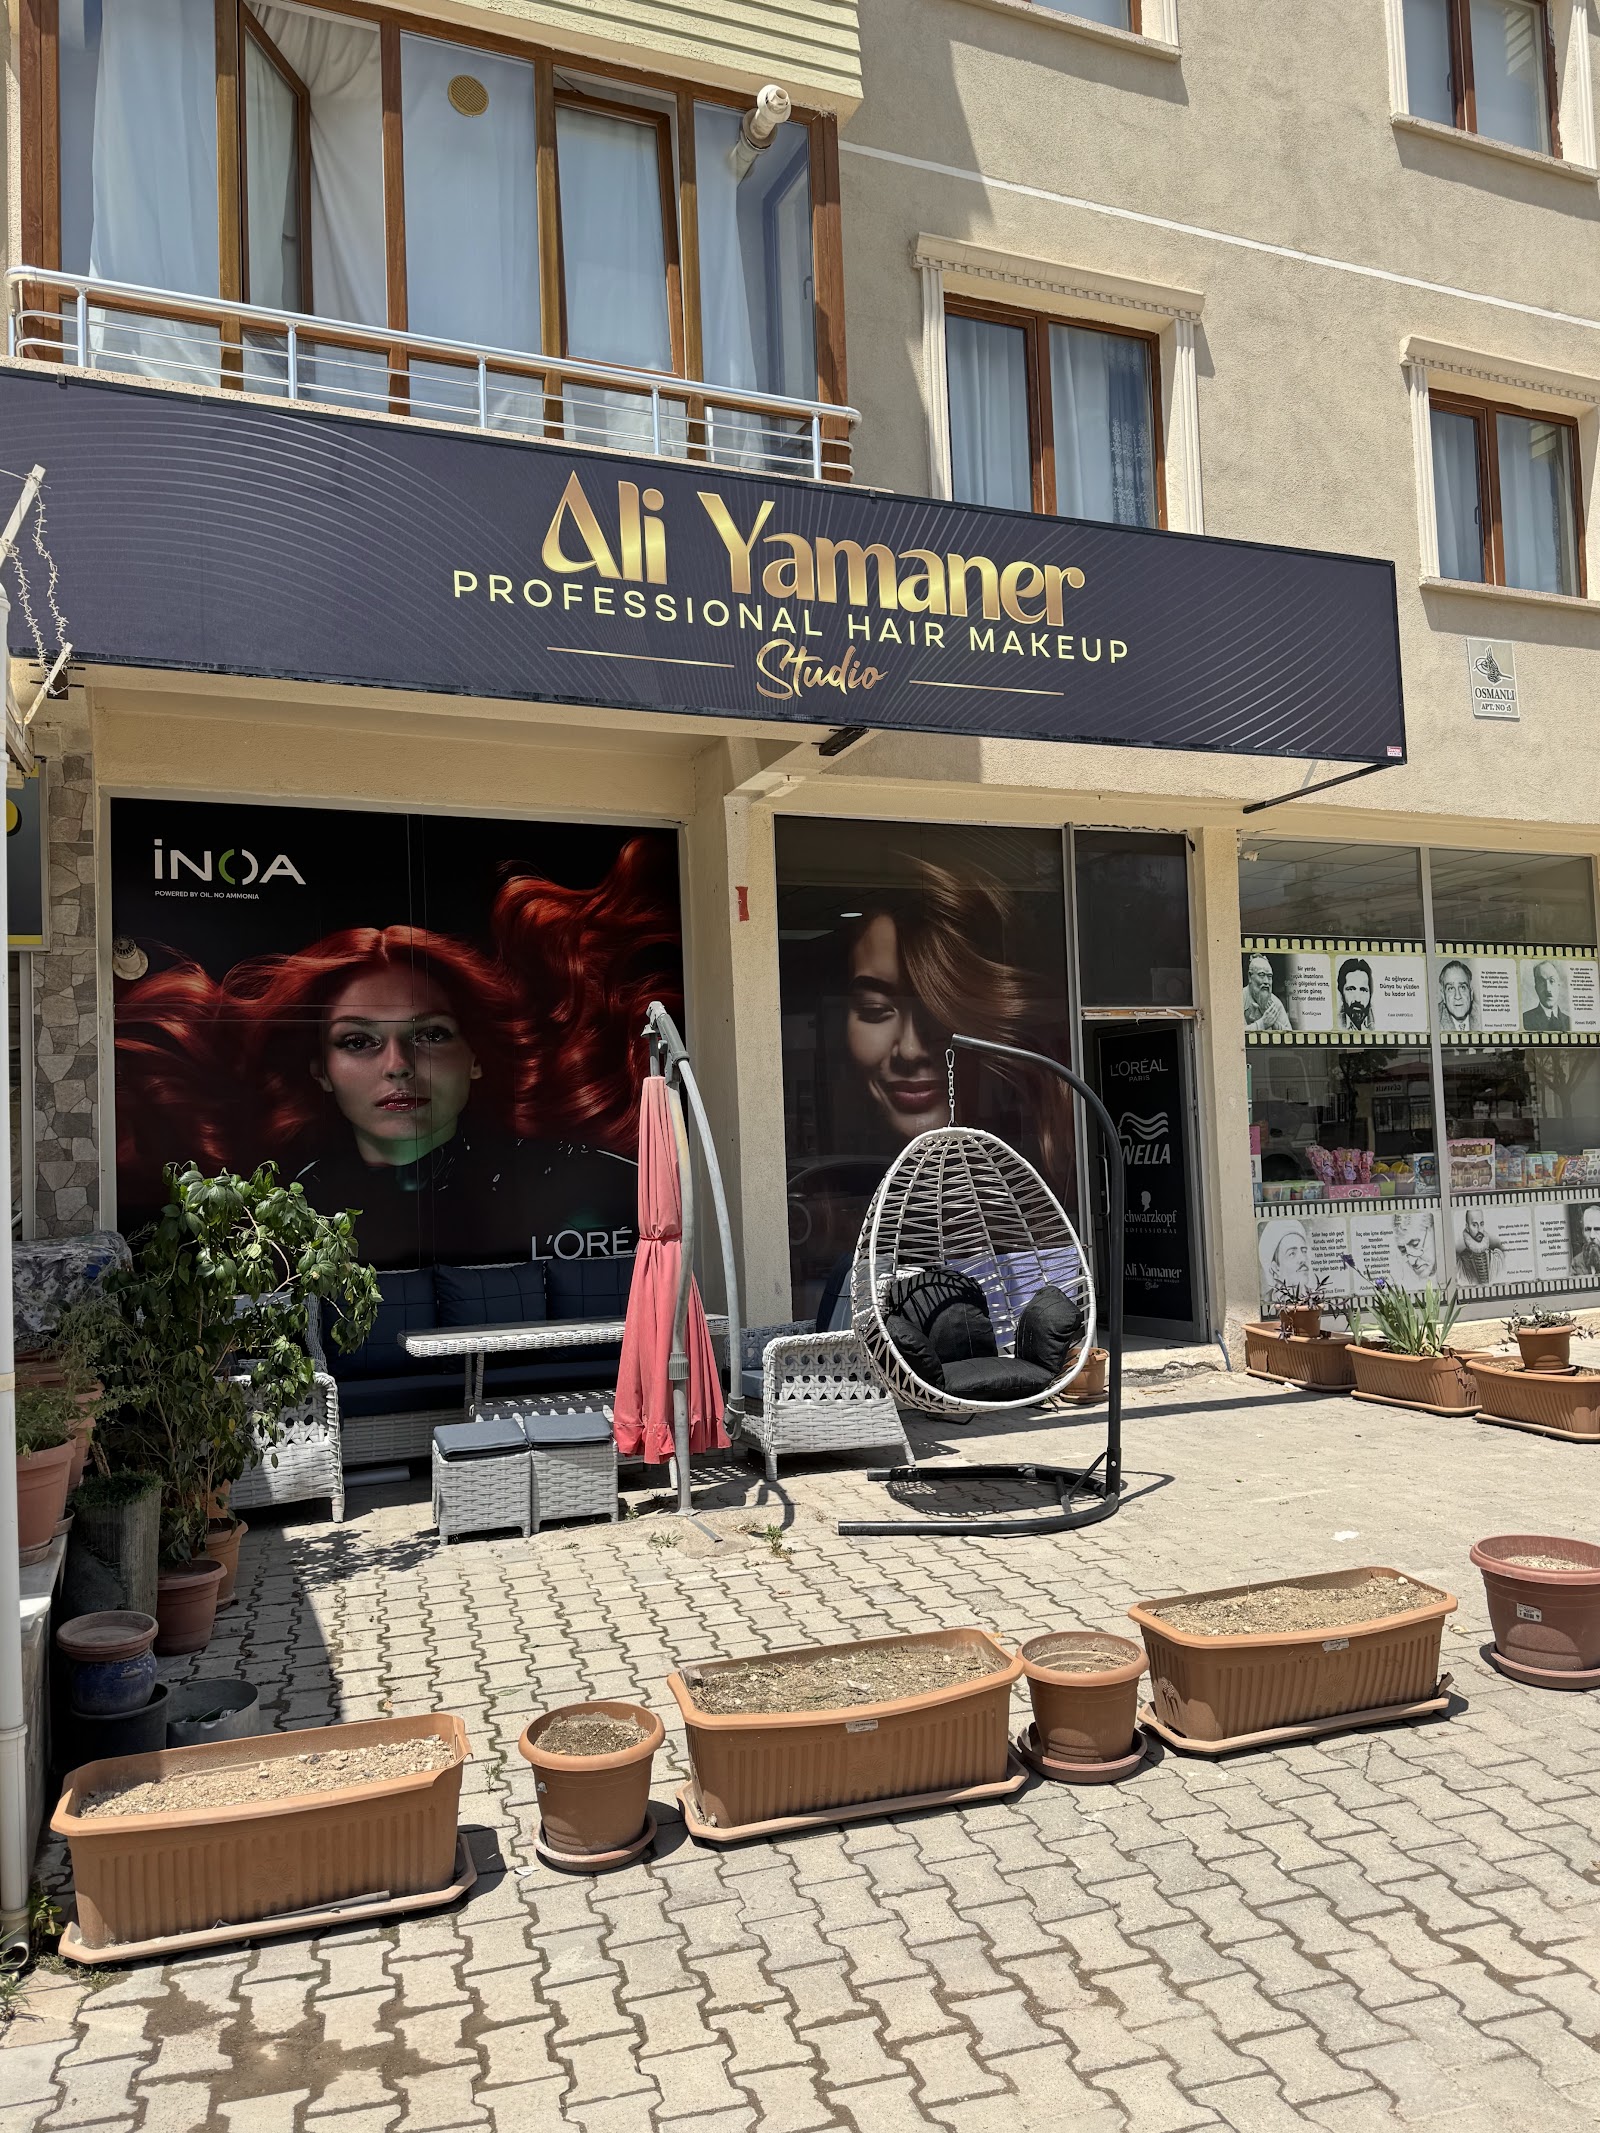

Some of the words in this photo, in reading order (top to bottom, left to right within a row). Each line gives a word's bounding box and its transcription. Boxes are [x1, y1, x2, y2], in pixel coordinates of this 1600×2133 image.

[541, 469, 667, 585] Ali
[697, 491, 1086, 627] Yamaner
[453, 570, 823, 637] PROFESSIONAL
[848, 612, 946, 648] HAIR
[969, 625, 1130, 664] MAKEUP
[756, 638, 887, 700] Studio
[1475, 688, 1515, 700] OSMANLI
[1110, 1058, 1168, 1077] L'ORÉAL
[1124, 1210, 1177, 1227] chwarzkopf
[532, 1226, 638, 1260] L'ORÉ
[1125, 1263, 1137, 1276] Ali
[1139, 1263, 1182, 1278] Yamaner
